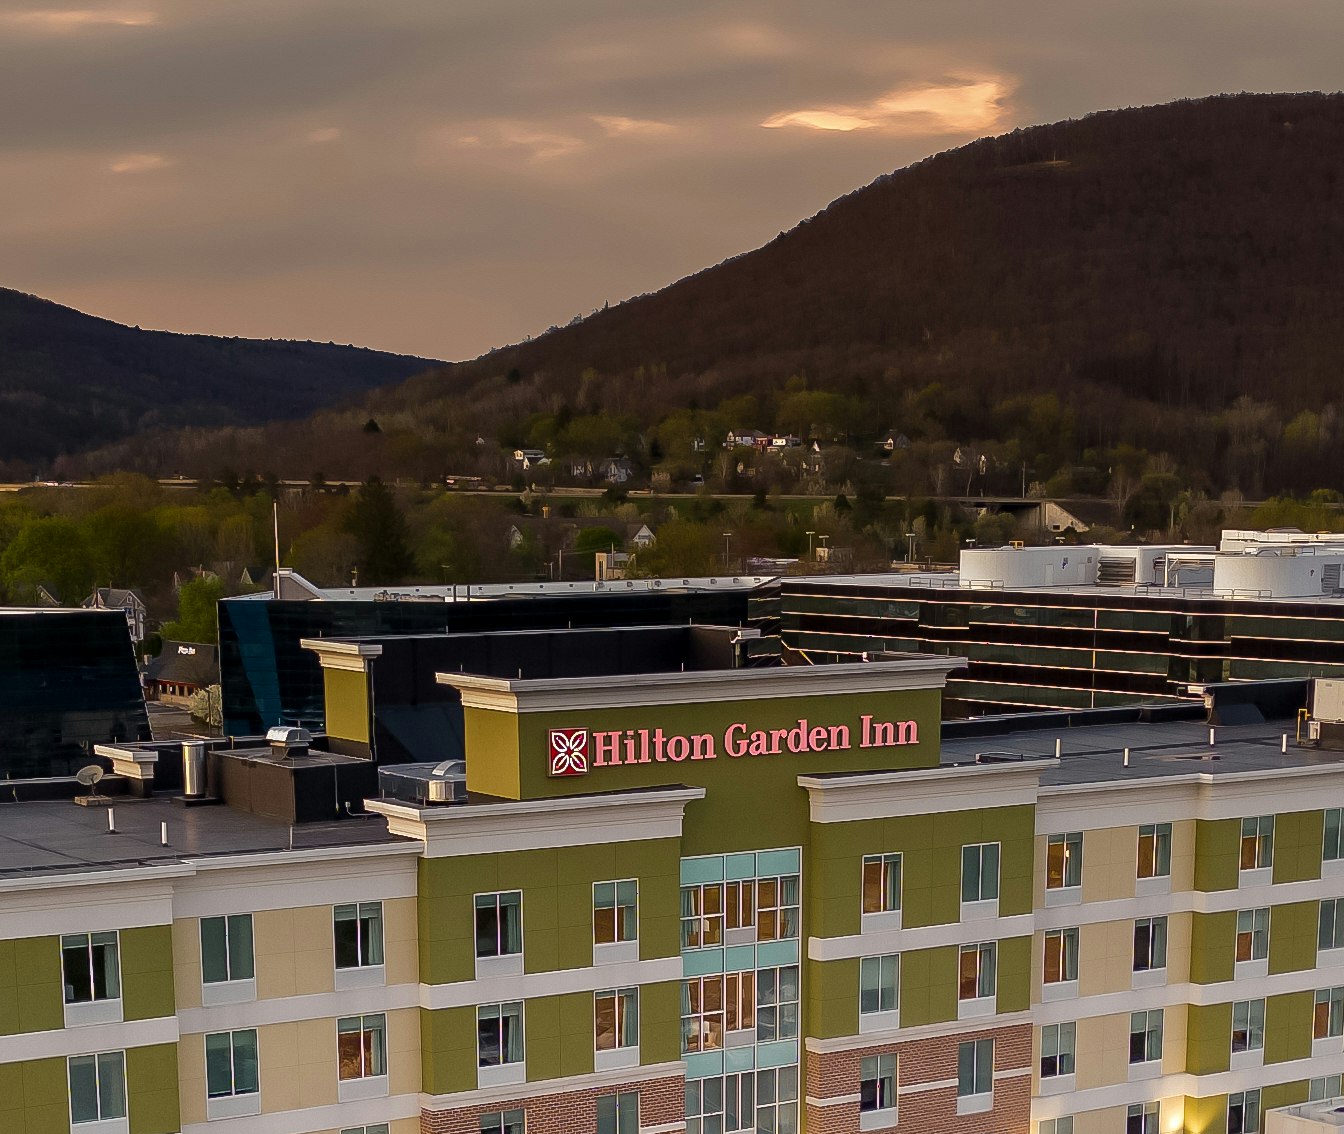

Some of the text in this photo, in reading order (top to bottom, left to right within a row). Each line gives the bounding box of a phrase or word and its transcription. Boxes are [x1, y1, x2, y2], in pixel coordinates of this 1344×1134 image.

[592, 715, 920, 767] Hilton Garden Inn
